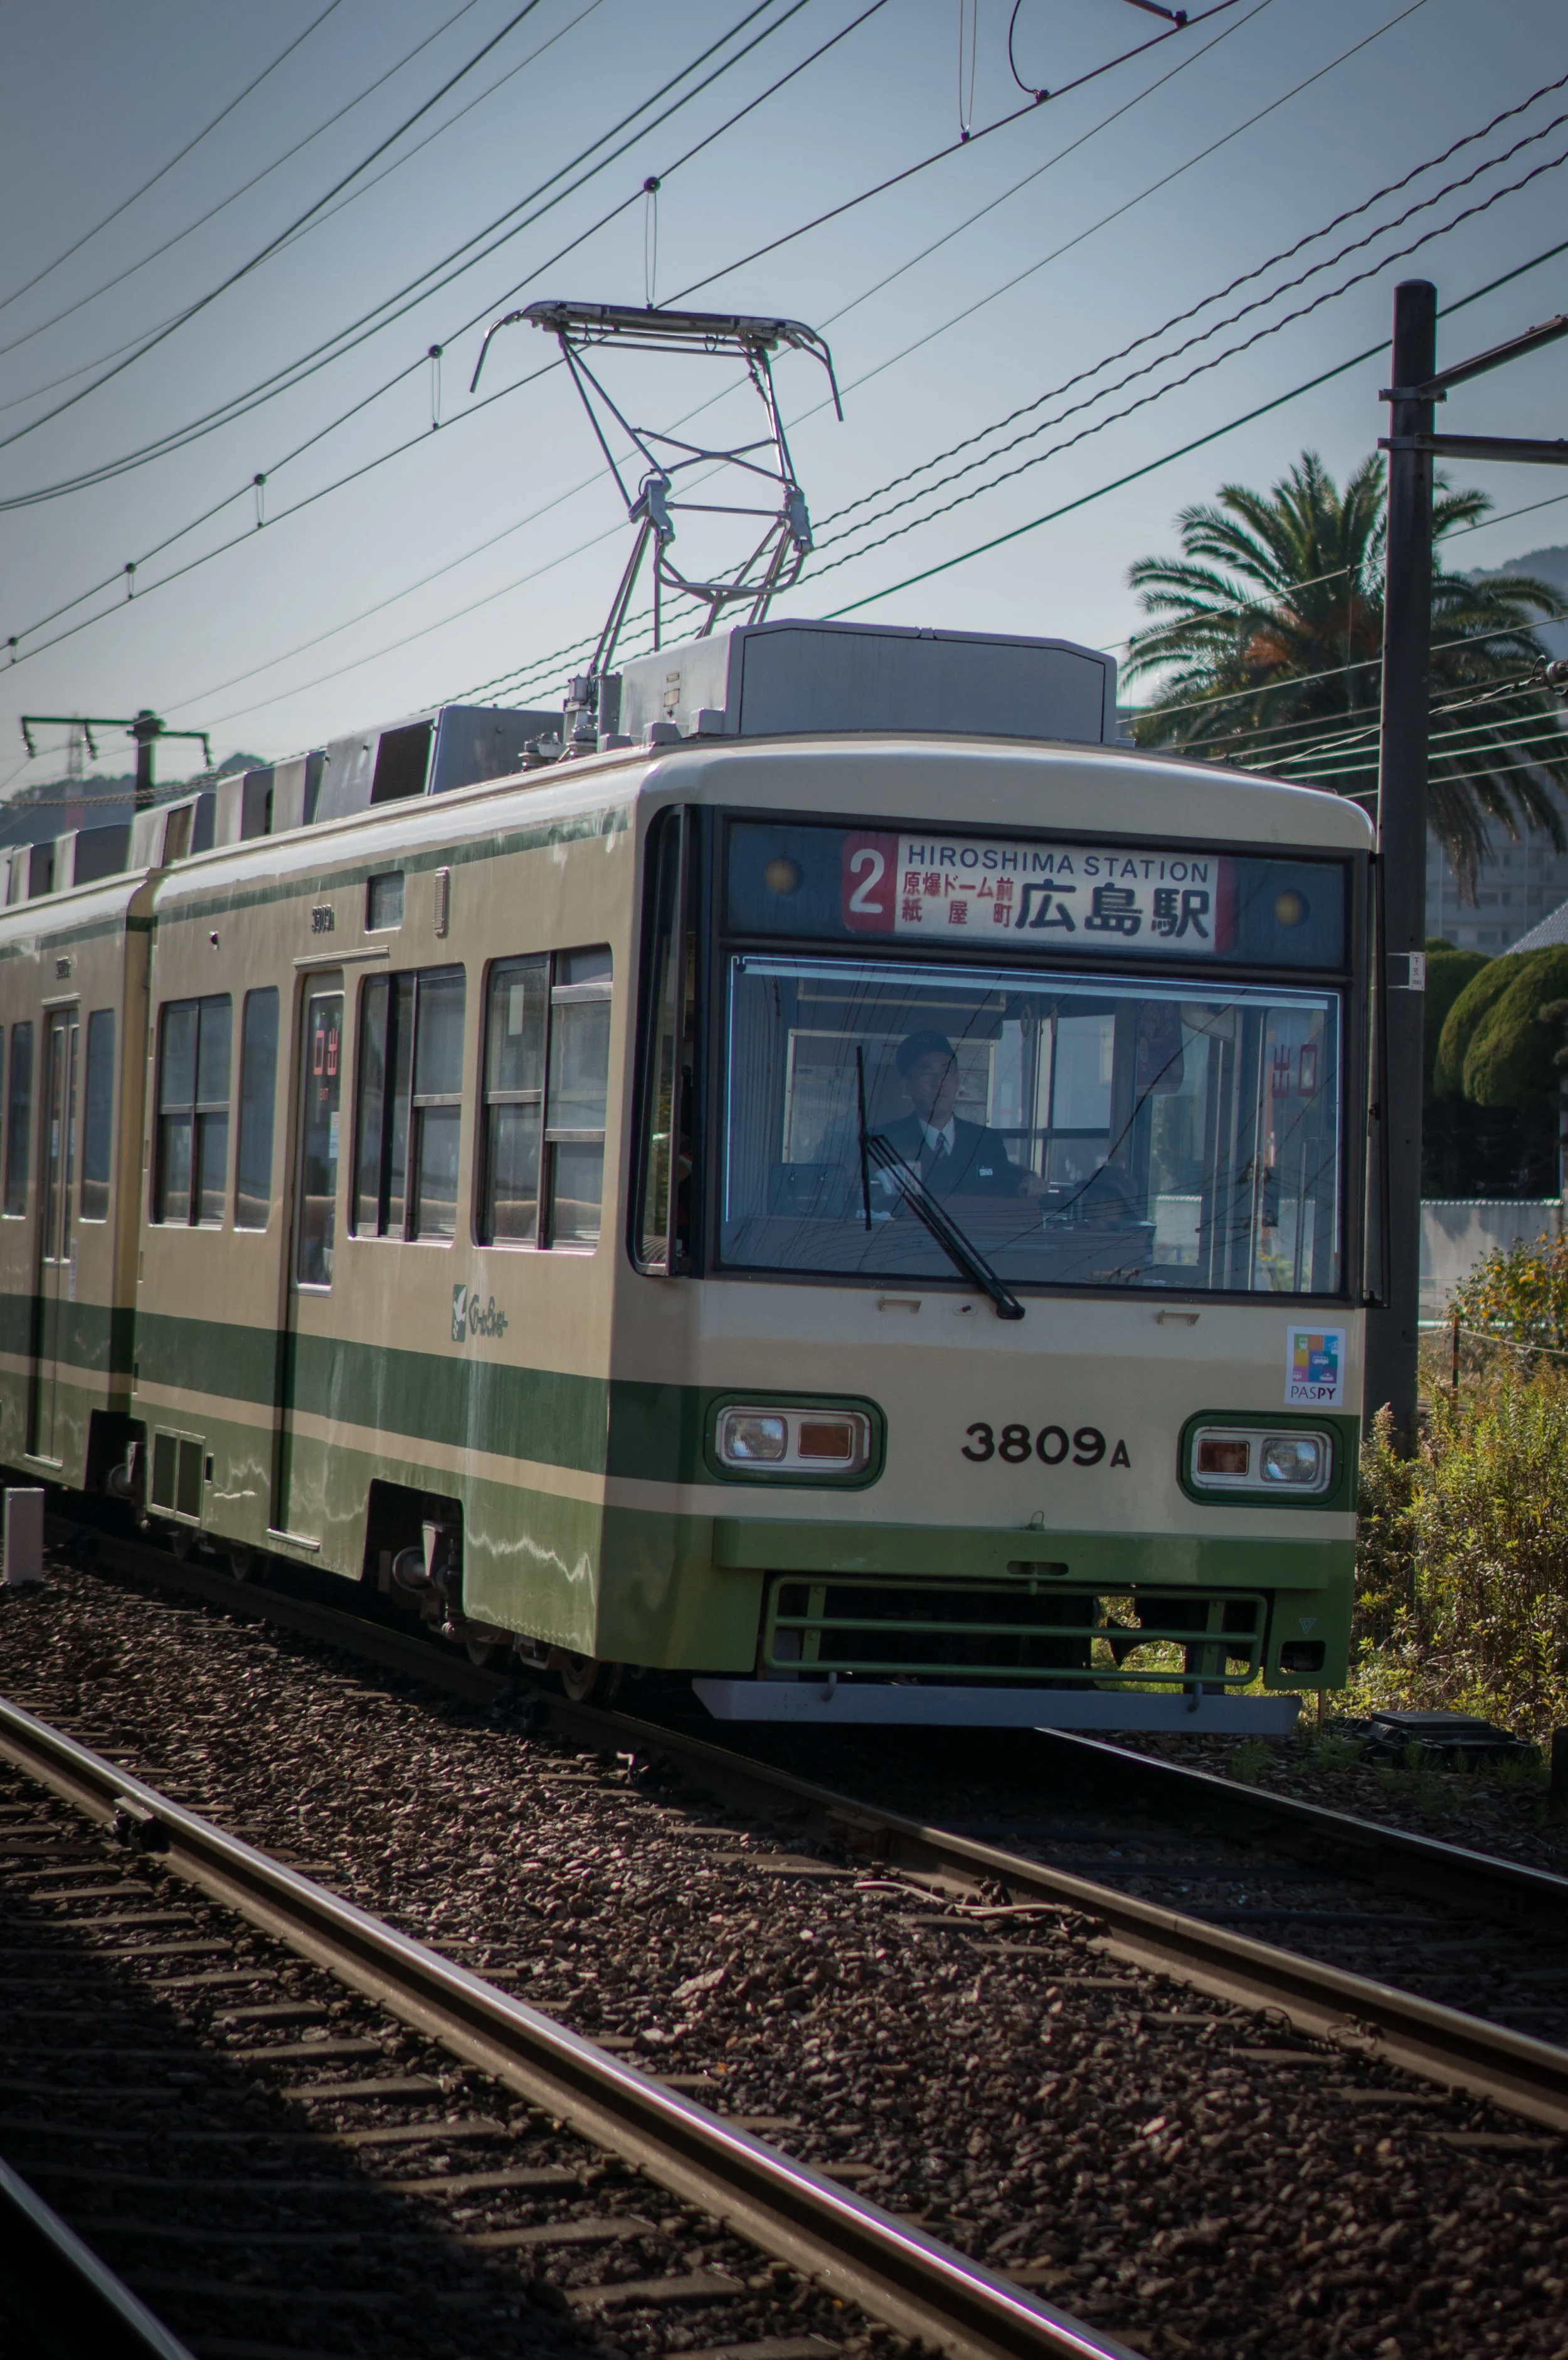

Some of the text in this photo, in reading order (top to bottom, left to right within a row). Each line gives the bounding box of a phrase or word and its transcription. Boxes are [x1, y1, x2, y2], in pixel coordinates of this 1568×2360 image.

[849, 848, 885, 914] 2
[903, 871, 1015, 902] 原爆ドーム前
[908, 844, 1209, 883] HIROSHIMA STATION
[1014, 878, 1210, 938] 広島駅
[1272, 1044, 1318, 1098] 出口
[1290, 1385, 1337, 1401] PASPY
[960, 1422, 1131, 1469] 3809A
